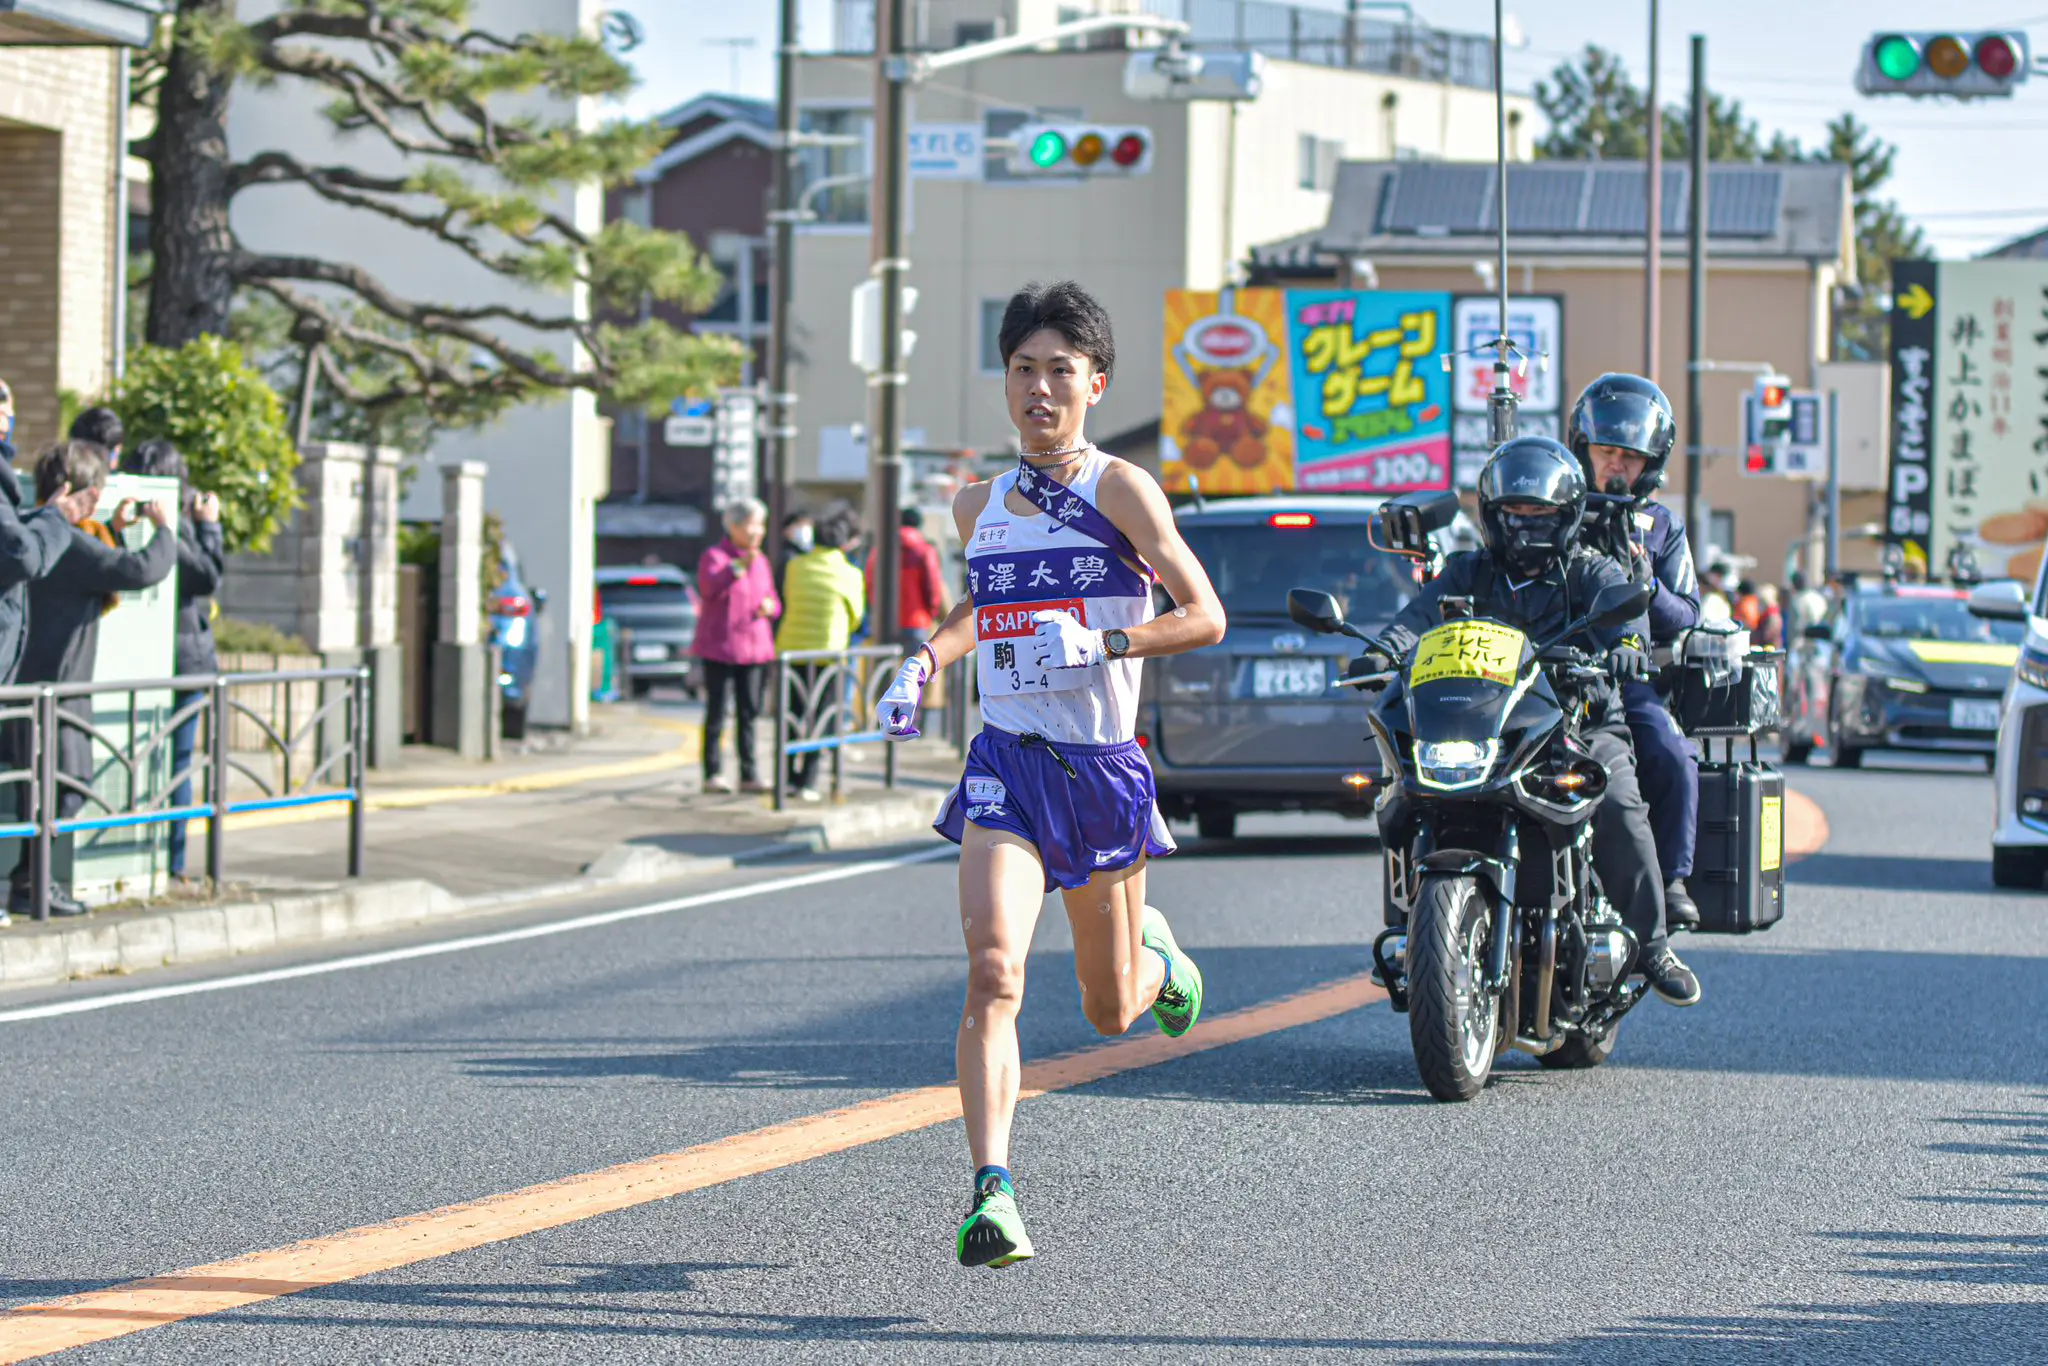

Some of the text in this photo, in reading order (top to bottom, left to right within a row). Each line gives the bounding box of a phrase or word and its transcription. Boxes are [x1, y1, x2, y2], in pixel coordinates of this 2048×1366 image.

[1303, 310, 1437, 373] クレーン
[1323, 359, 1426, 417] ゲーム
[1512, 475, 1540, 487] Arai
[1894, 464, 1929, 502] P
[995, 606, 1081, 632] SAPPO
